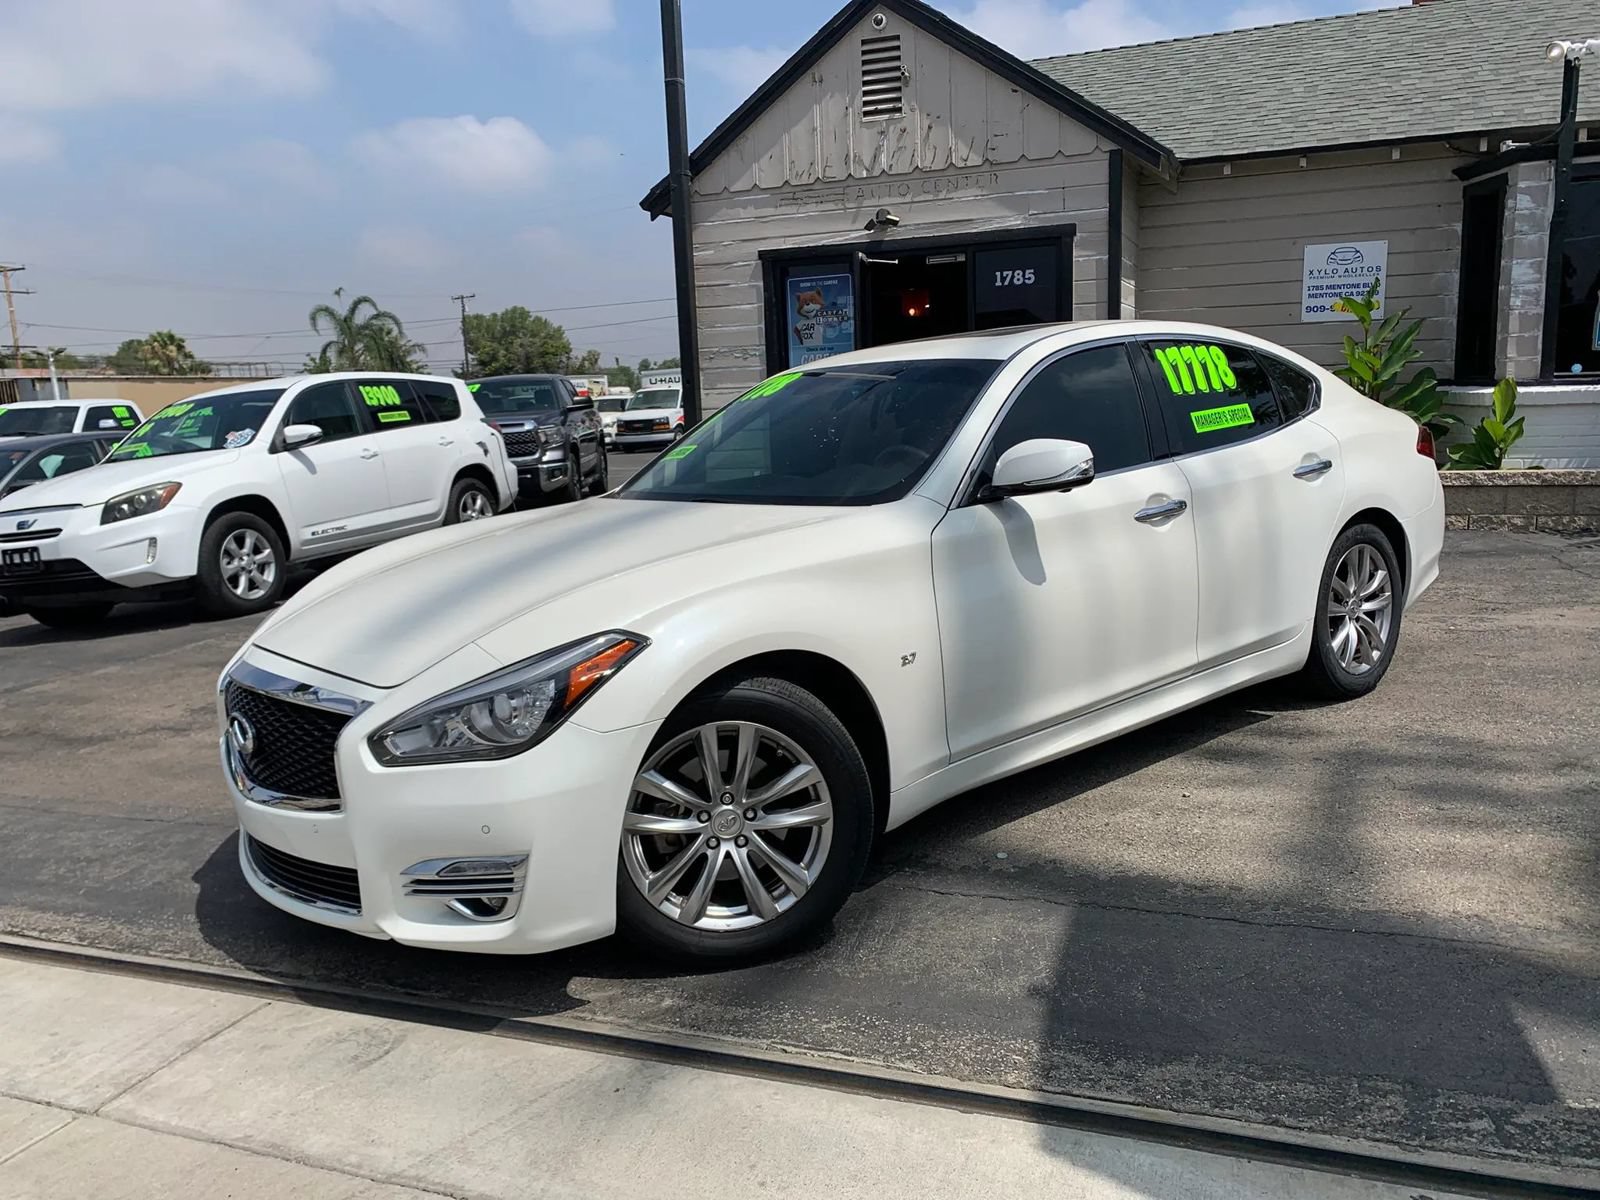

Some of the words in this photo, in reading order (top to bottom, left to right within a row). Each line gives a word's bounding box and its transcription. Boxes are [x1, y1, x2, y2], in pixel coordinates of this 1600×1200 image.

[1344, 266, 1382, 274] AUTOS
[995, 269, 1036, 286] 1785
[1325, 282, 1361, 291] MENTONE
[1307, 291, 1343, 299] MENTONE
[1344, 289, 1354, 297] CA
[1155, 345, 1237, 395] 17778
[649, 376, 681, 385] U-HAU
[359, 384, 401, 406] 13900
[16, 519, 38, 531] EV
